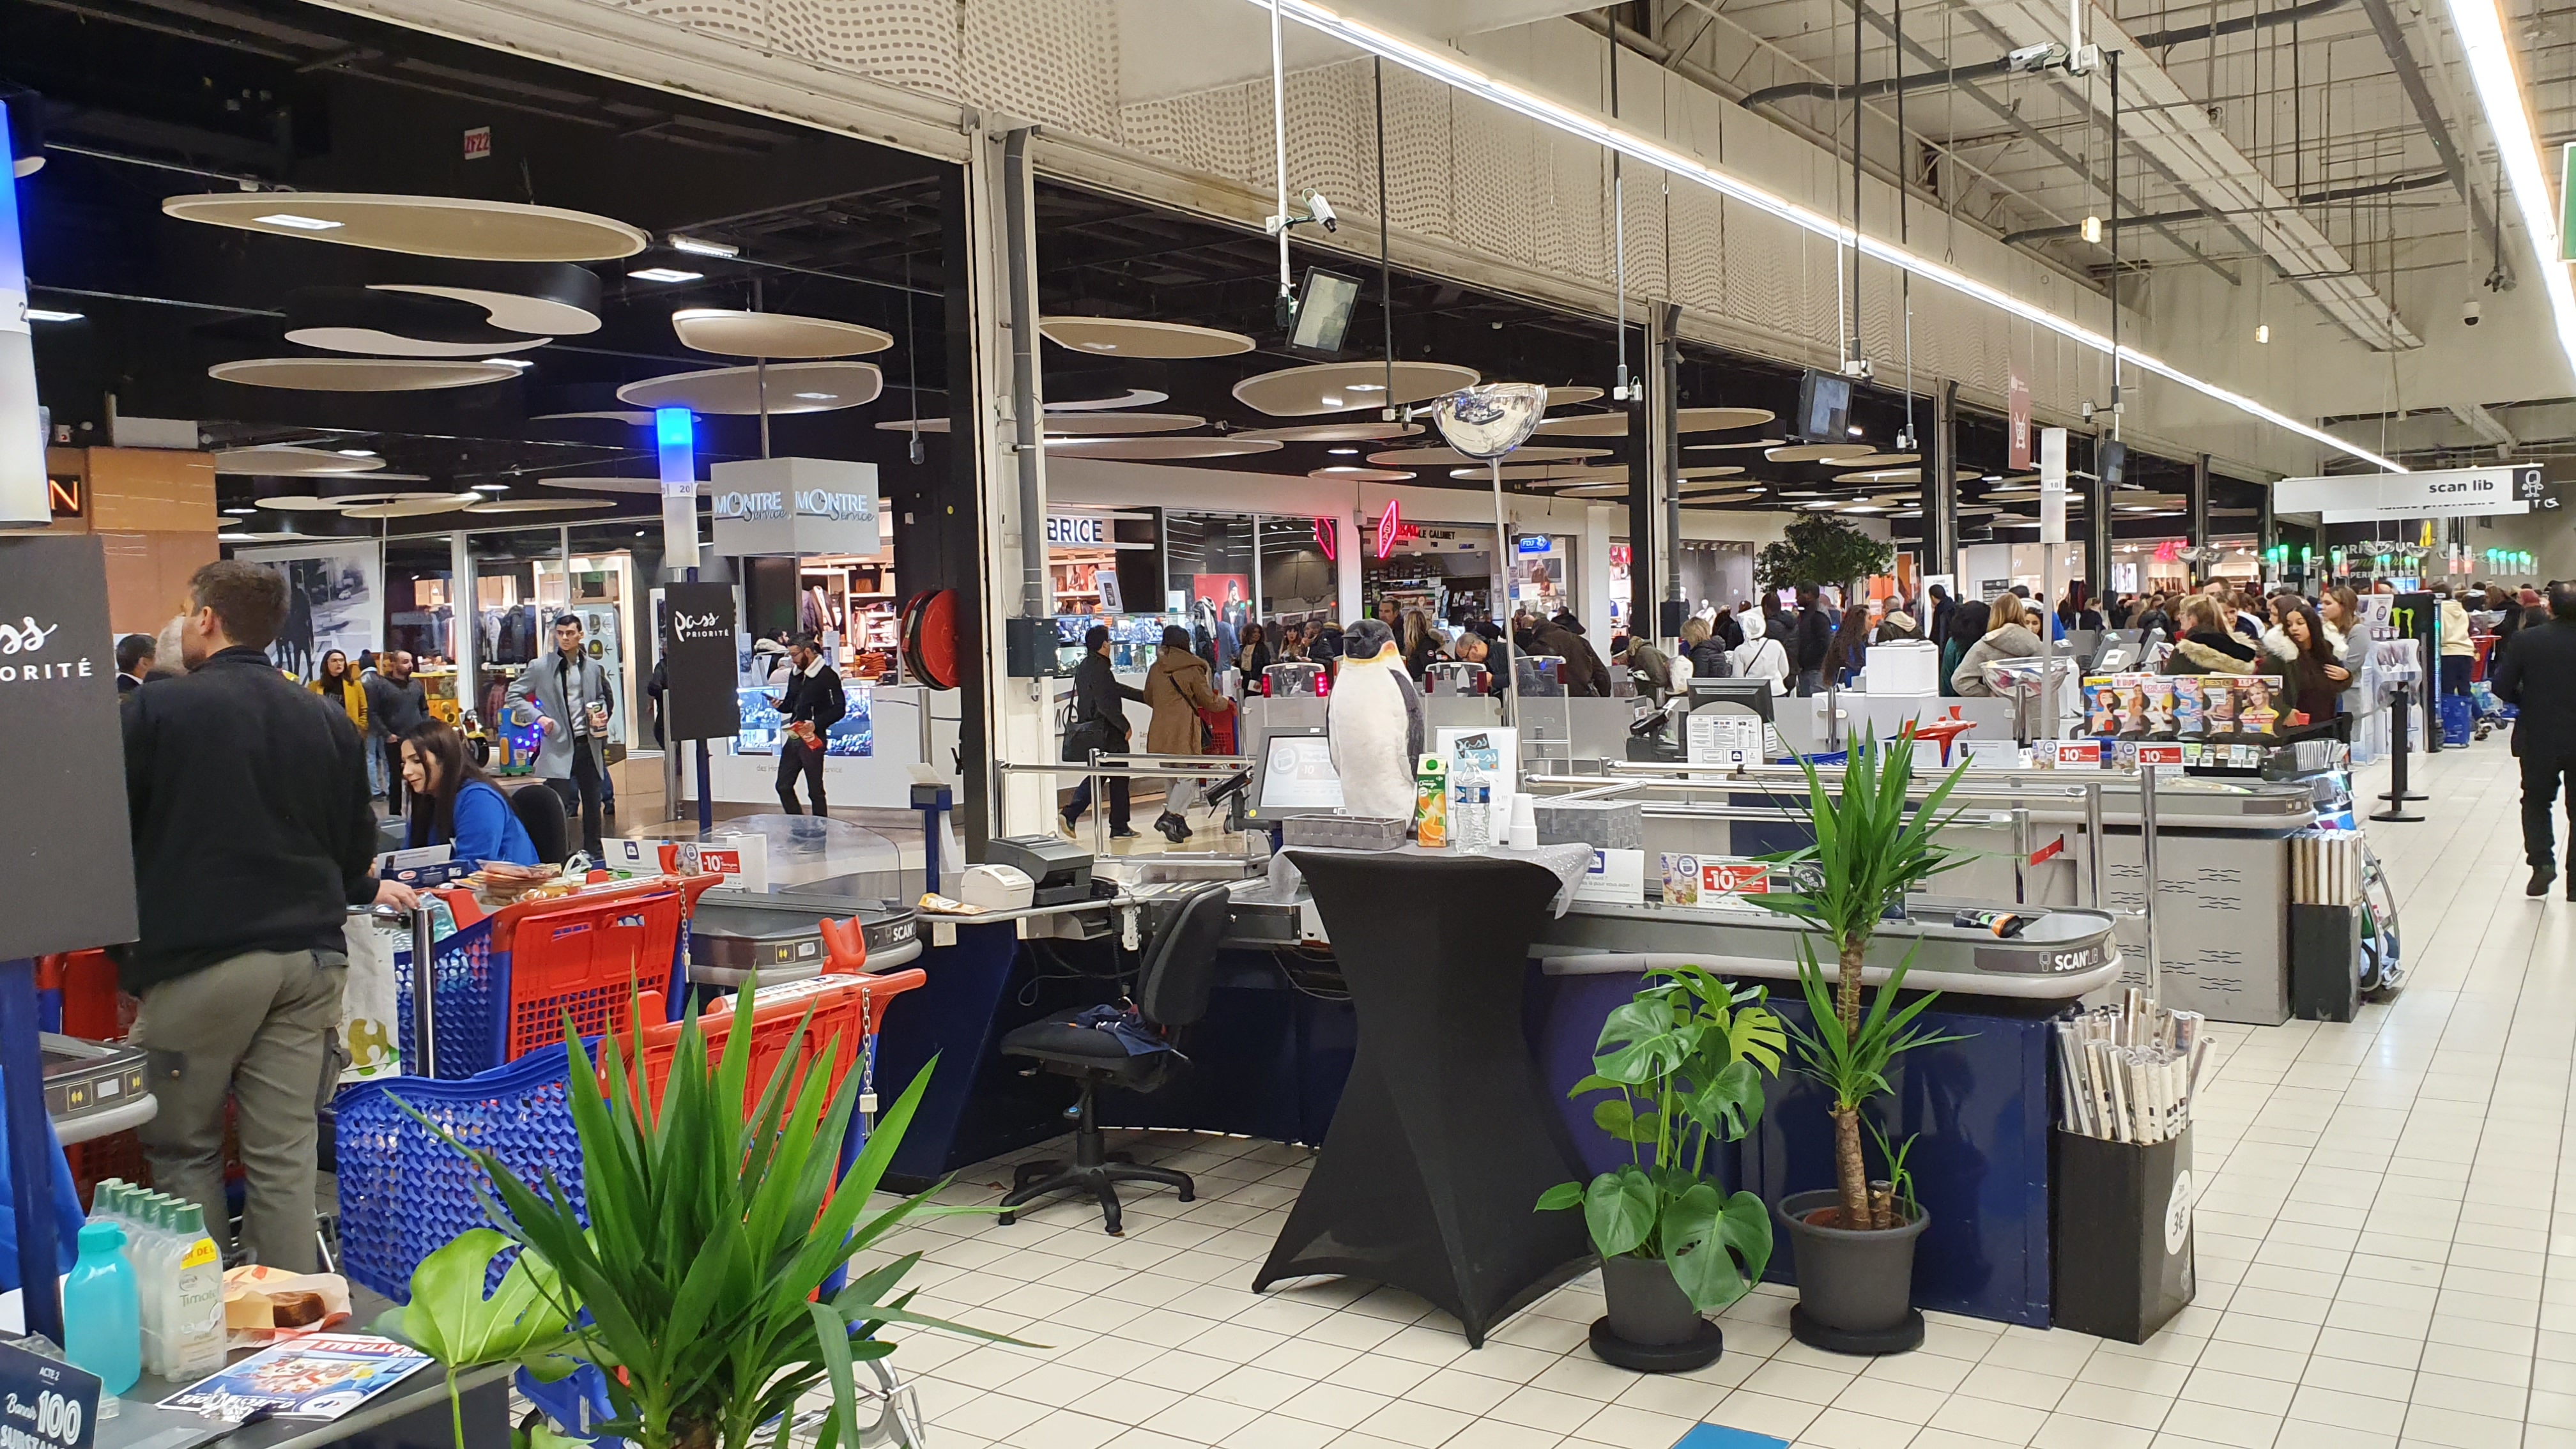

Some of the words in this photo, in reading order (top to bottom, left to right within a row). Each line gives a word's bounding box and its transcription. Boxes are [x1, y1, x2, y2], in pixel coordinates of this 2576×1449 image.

[2429, 482, 2467, 493] scan
[2473, 480, 2494, 491] lib
[714, 491, 781, 516] MONTRE
[795, 488, 868, 513] MONTRE
[1046, 518, 1103, 544] BRICE
[675, 611, 719, 642] pass
[686, 629, 729, 638] PRIORITÉ
[37, 1390, 81, 1445] 100
